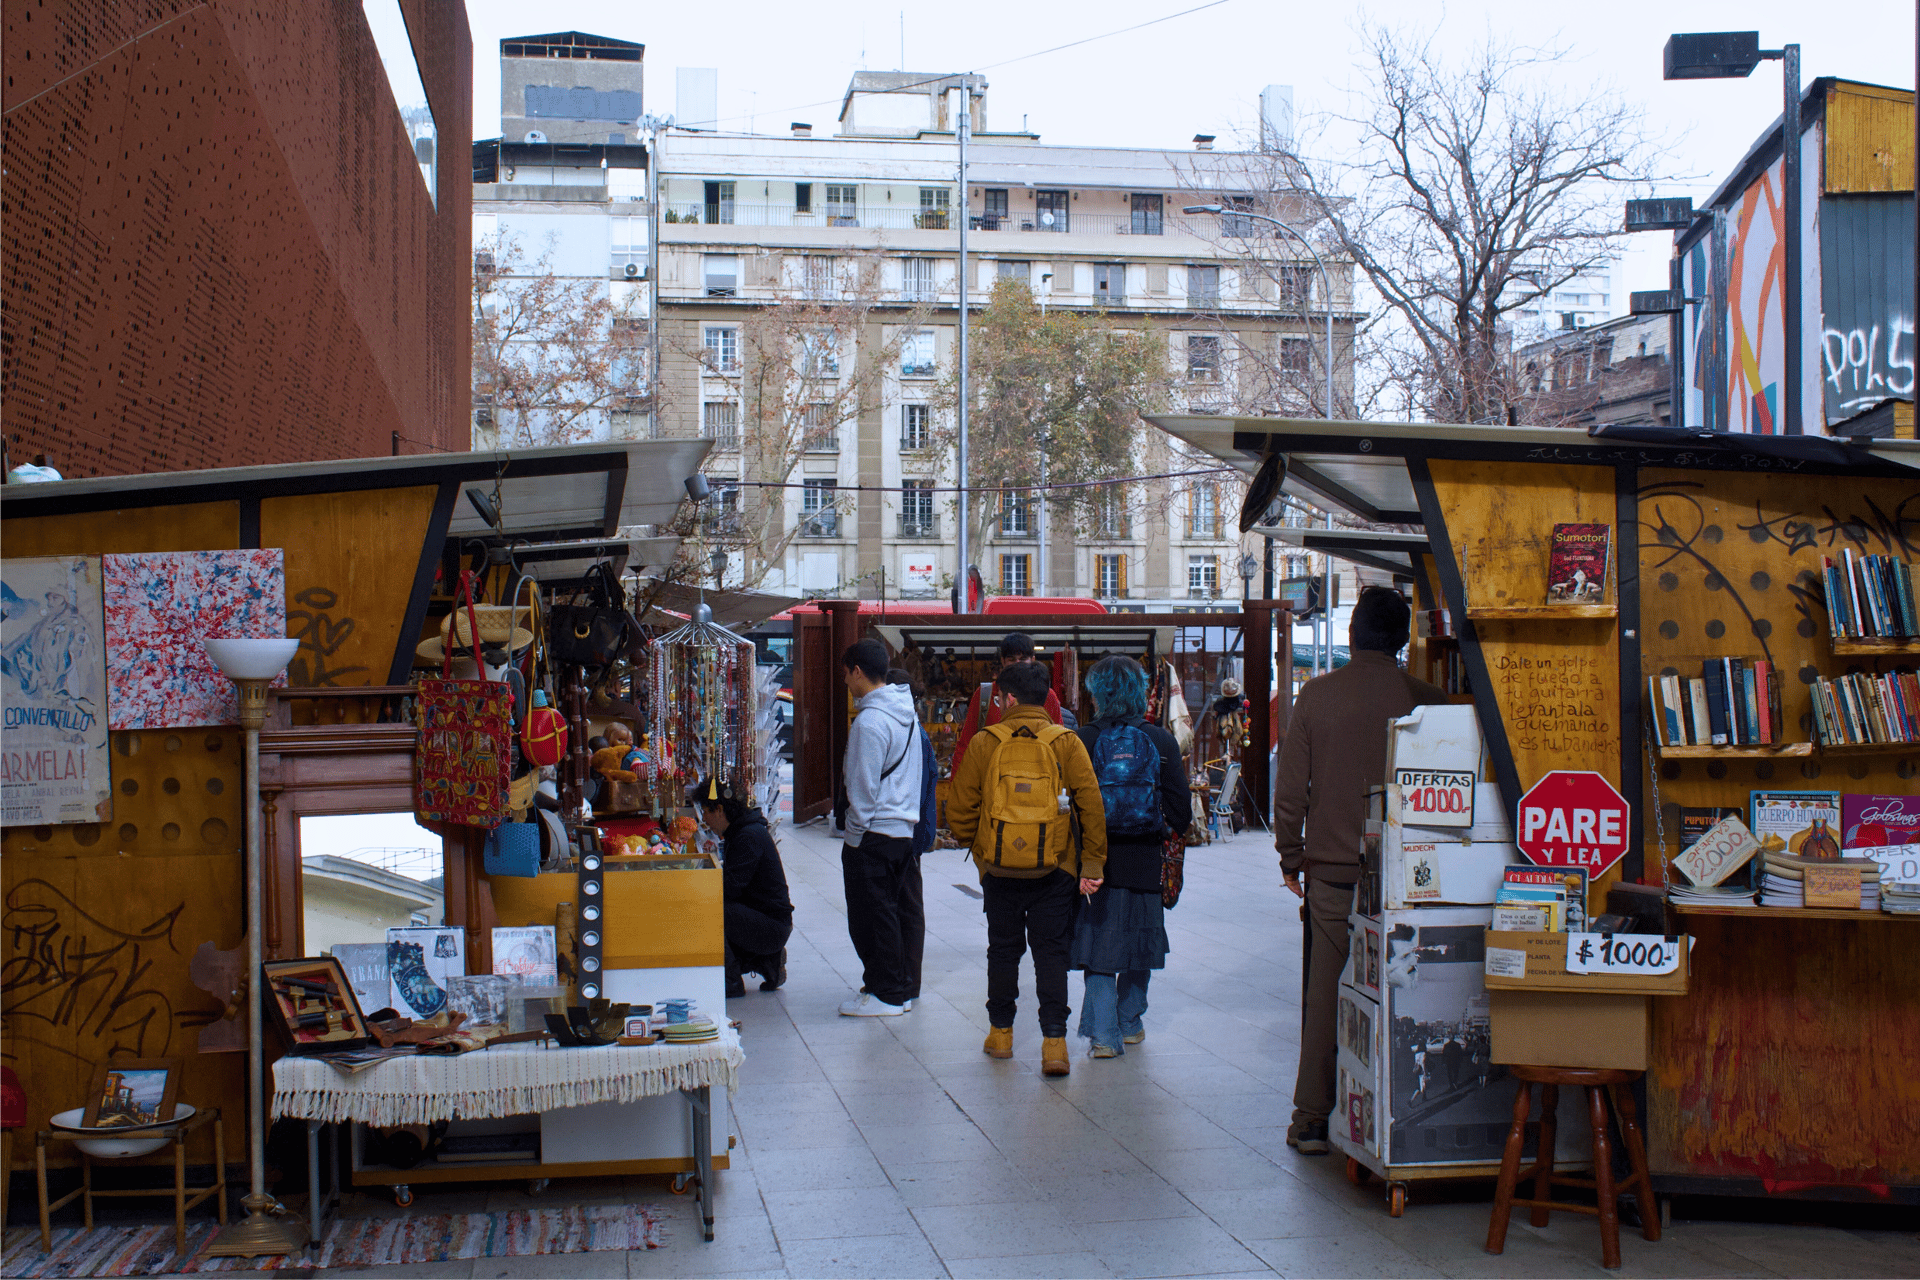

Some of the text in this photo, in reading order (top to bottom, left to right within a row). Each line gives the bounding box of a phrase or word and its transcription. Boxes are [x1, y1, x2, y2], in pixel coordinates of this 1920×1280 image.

[1556, 533, 1606, 542] Sumotori
[1537, 659, 1551, 668] un
[1557, 655, 1598, 673] golpe
[1501, 670, 1602, 687] de fuego a
[1505, 684, 1604, 704] tu guitarra
[5, 707, 90, 731] CONVENTILLO
[1516, 719, 1609, 736] quemando
[1519, 736, 1538, 750] es
[1541, 732, 1557, 750] tu
[1402, 773, 1470, 787] OFERTAS
[1758, 808, 1836, 823] CUERPO HUMANO
[1860, 800, 1919, 825] Golosinas
[1525, 807, 1621, 844] PARE
[1404, 844, 1436, 852] MUDECHI
[1541, 847, 1602, 865] Y LEA
